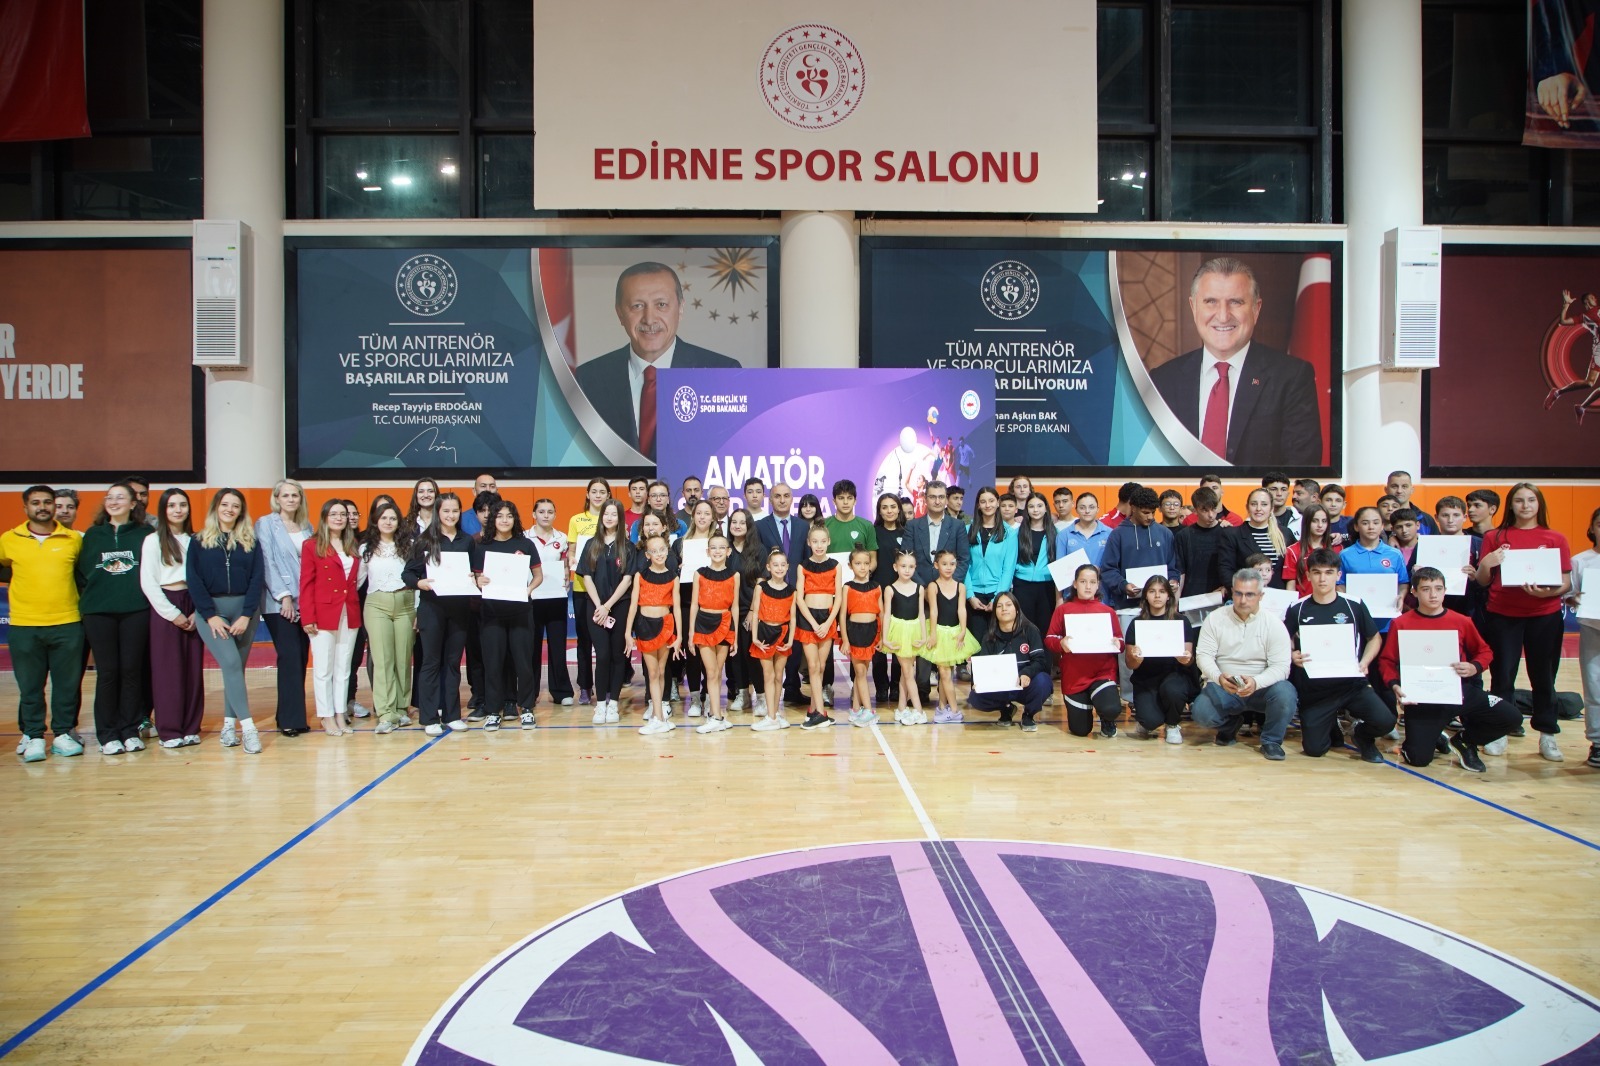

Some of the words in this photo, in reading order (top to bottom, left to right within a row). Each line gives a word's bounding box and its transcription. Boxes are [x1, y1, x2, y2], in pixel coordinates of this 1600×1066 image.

[798, 43, 827, 52] GENÇLİK
[828, 49, 836, 57] VE
[835, 56, 846, 76] SPOR
[594, 140, 743, 180] EDİRNE
[754, 148, 863, 181] SPOR
[874, 150, 1039, 184] SALONU
[359, 333, 397, 350] TÜM
[402, 333, 495, 350] ANTRENÖR
[945, 340, 982, 357] TÜM
[986, 340, 1075, 357] ANTRENÖR
[339, 353, 360, 368] VE
[365, 352, 515, 368] SPORCULARIMIZA
[951, 359, 1094, 374] SPORCULARIMIZA
[0, 364, 84, 399] YERDE
[345, 372, 425, 387] BAŞARILAR
[429, 370, 509, 384] DİLİYORUM
[1012, 376, 1088, 390] DİLİYORUM
[372, 403, 400, 413] Recep
[402, 403, 432, 413] Tayyip
[434, 401, 482, 411] ERDOĞAN
[700, 395, 711, 403] T.C.
[712, 394, 738, 405] GENÇLİK
[739, 395, 748, 403] VE
[700, 405, 716, 413] SPOR
[716, 403, 748, 413] BAKANLIĞI
[373, 415, 391, 425] T.C.
[392, 415, 481, 426] CUMHURBAŞKANI
[1012, 411, 1037, 422] Aşkın
[1038, 411, 1057, 420] BAK
[1007, 424, 1033, 433] SPOR
[1034, 424, 1070, 433] BAKANI
[703, 448, 825, 490] AMATÖR
